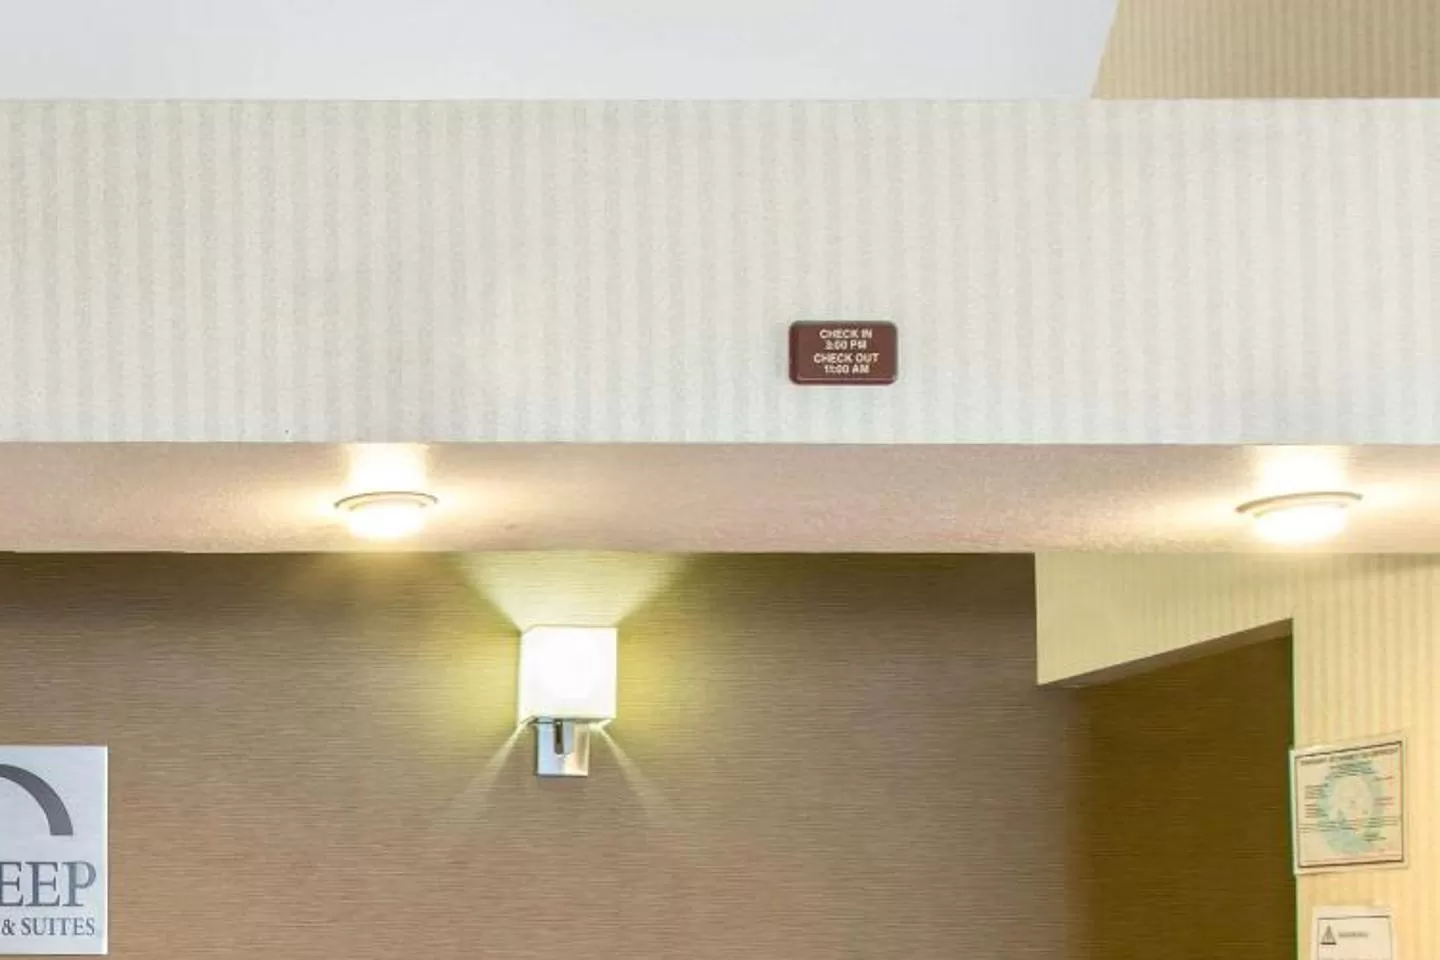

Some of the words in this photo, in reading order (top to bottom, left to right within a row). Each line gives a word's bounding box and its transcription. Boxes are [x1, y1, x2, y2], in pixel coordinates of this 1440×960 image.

[819, 328, 859, 339] CHECK
[861, 328, 873, 339] IN
[850, 339, 868, 350] PM
[813, 352, 854, 363] CHECK
[855, 352, 880, 363] OUT
[851, 364, 871, 375] AM
[1, 918, 16, 936] &
[20, 916, 96, 937] SUITES
